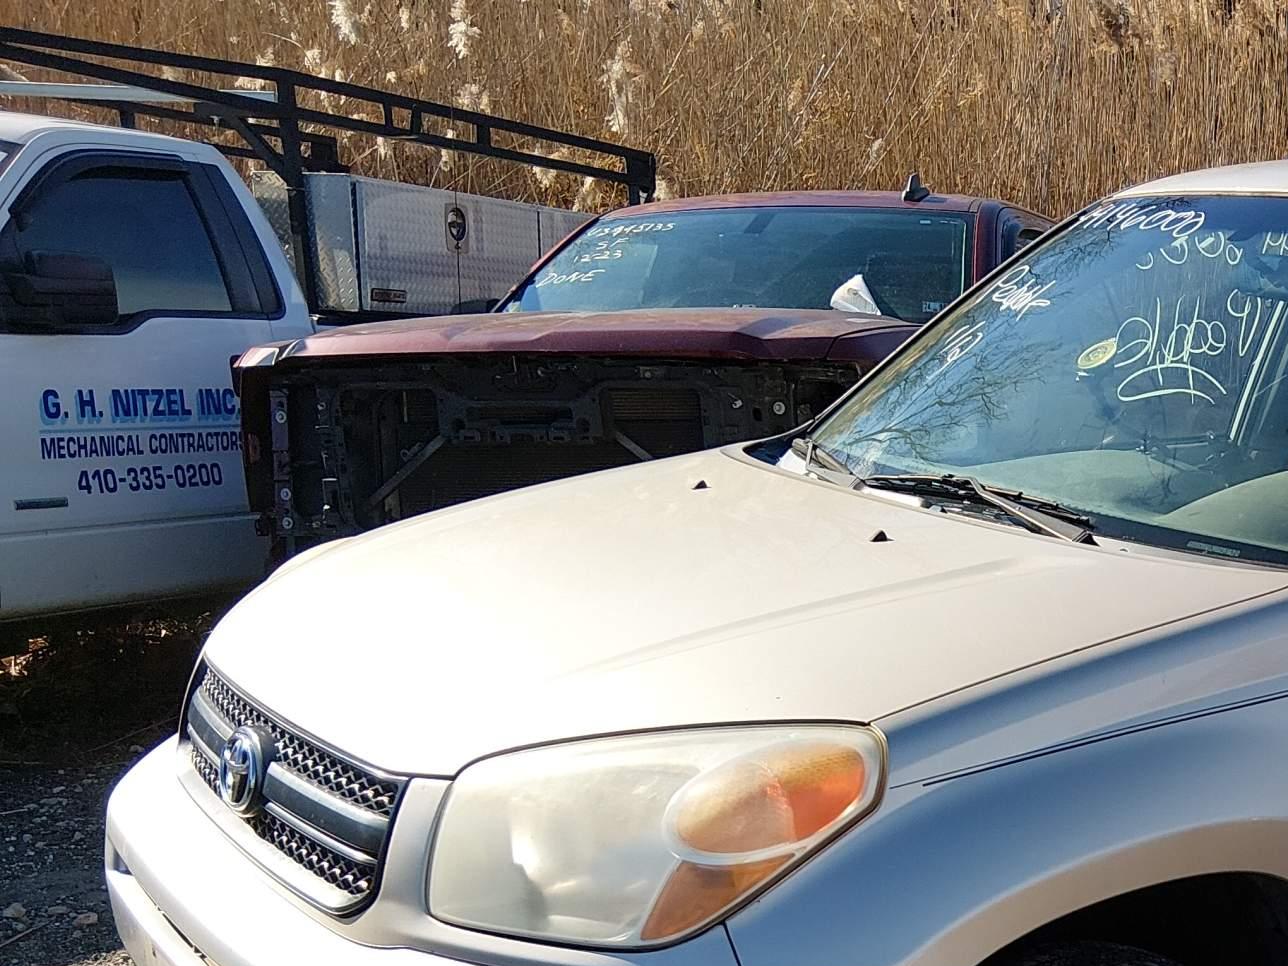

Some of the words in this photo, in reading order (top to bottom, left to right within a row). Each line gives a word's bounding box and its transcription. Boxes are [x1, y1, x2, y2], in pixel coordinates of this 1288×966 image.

[536, 269, 606, 288] DONE
[40, 389, 69, 425] G.
[75, 389, 104, 424] H.
[110, 388, 193, 424] NITZEL
[40, 435, 144, 460] MECHANICAL
[77, 462, 223, 494] 410-335-0200
